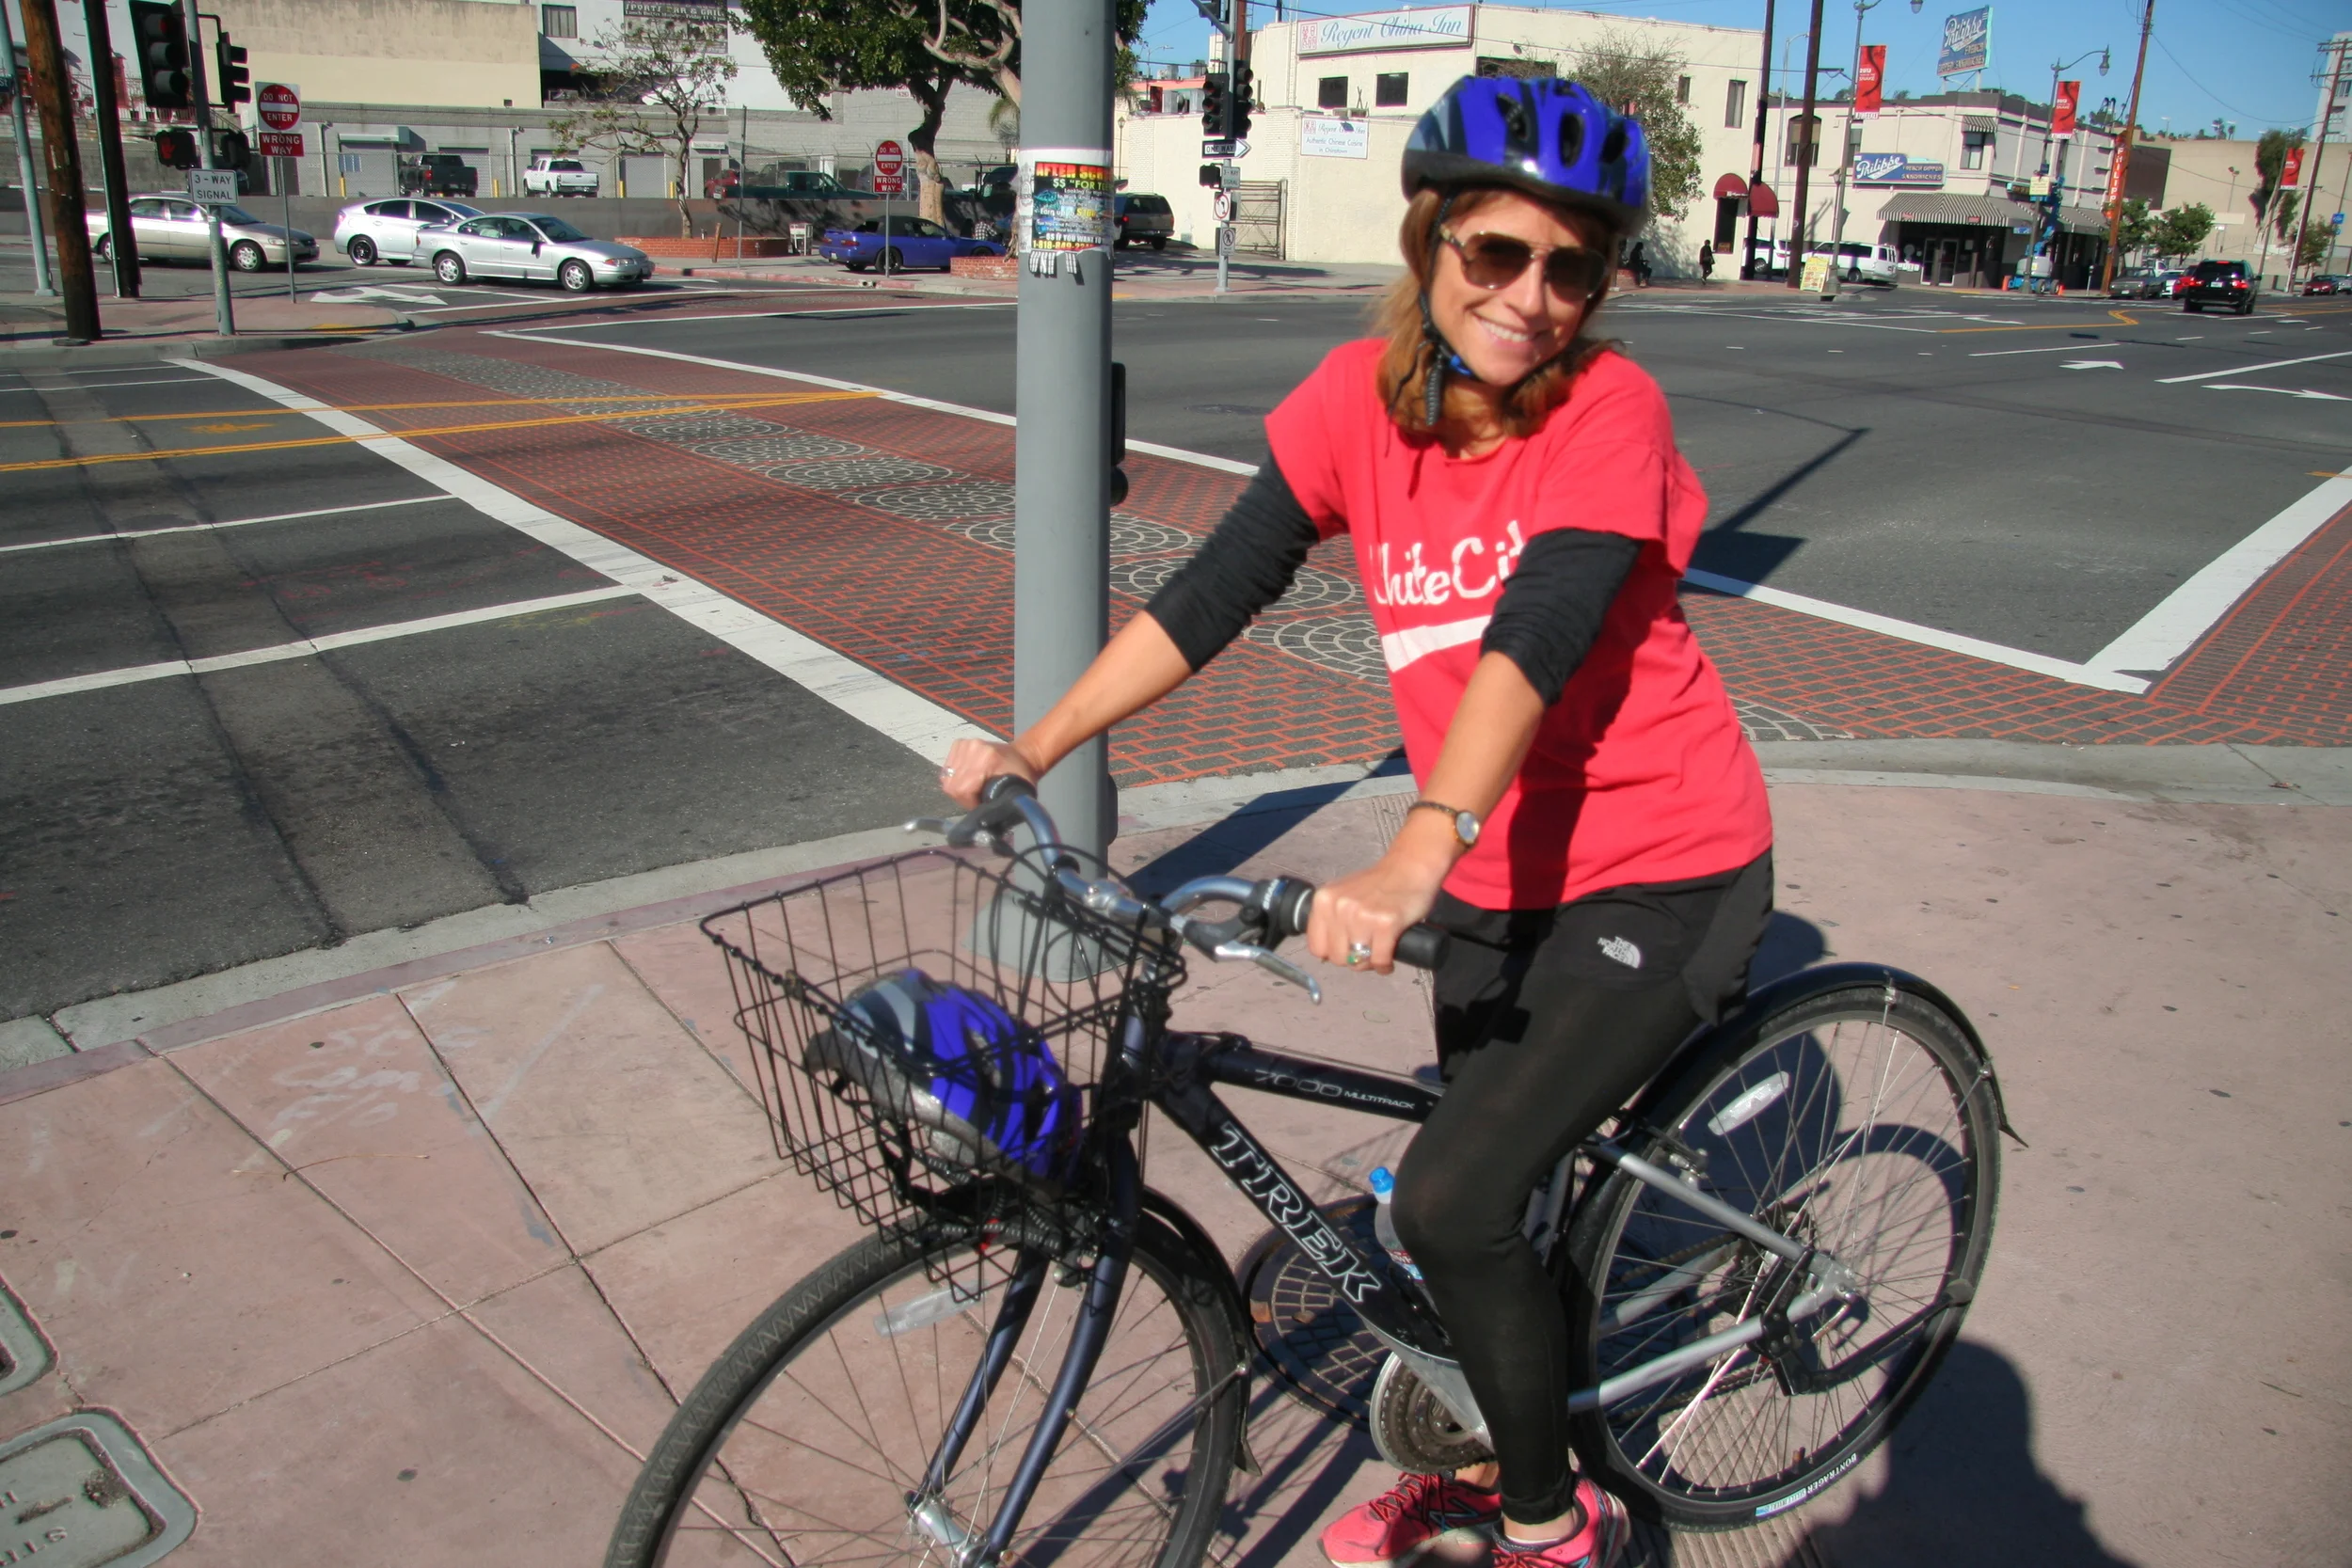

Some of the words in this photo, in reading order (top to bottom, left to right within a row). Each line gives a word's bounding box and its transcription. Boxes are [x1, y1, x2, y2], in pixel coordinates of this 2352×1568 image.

[1321, 22, 1375, 49] Regent
[1379, 16, 1423, 38] China
[1429, 11, 1462, 34] Inn
[278, 94, 293, 103] NOT
[267, 113, 293, 121] ENTER
[262, 135, 300, 144] WRONG
[271, 146, 293, 154] WAY
[1036, 162, 1076, 178] AFTER
[1856, 155, 1901, 179] Philippe
[2109, 147, 2124, 206] PHILIPP
[197, 190, 233, 200] SIGNAL
[1254, 1069, 1343, 1099] 7000
[1343, 1089, 1416, 1111] MULTITRACK
[1210, 1119, 1383, 1304] TREK
[1807, 1451, 1858, 1495] BONTRAGER
